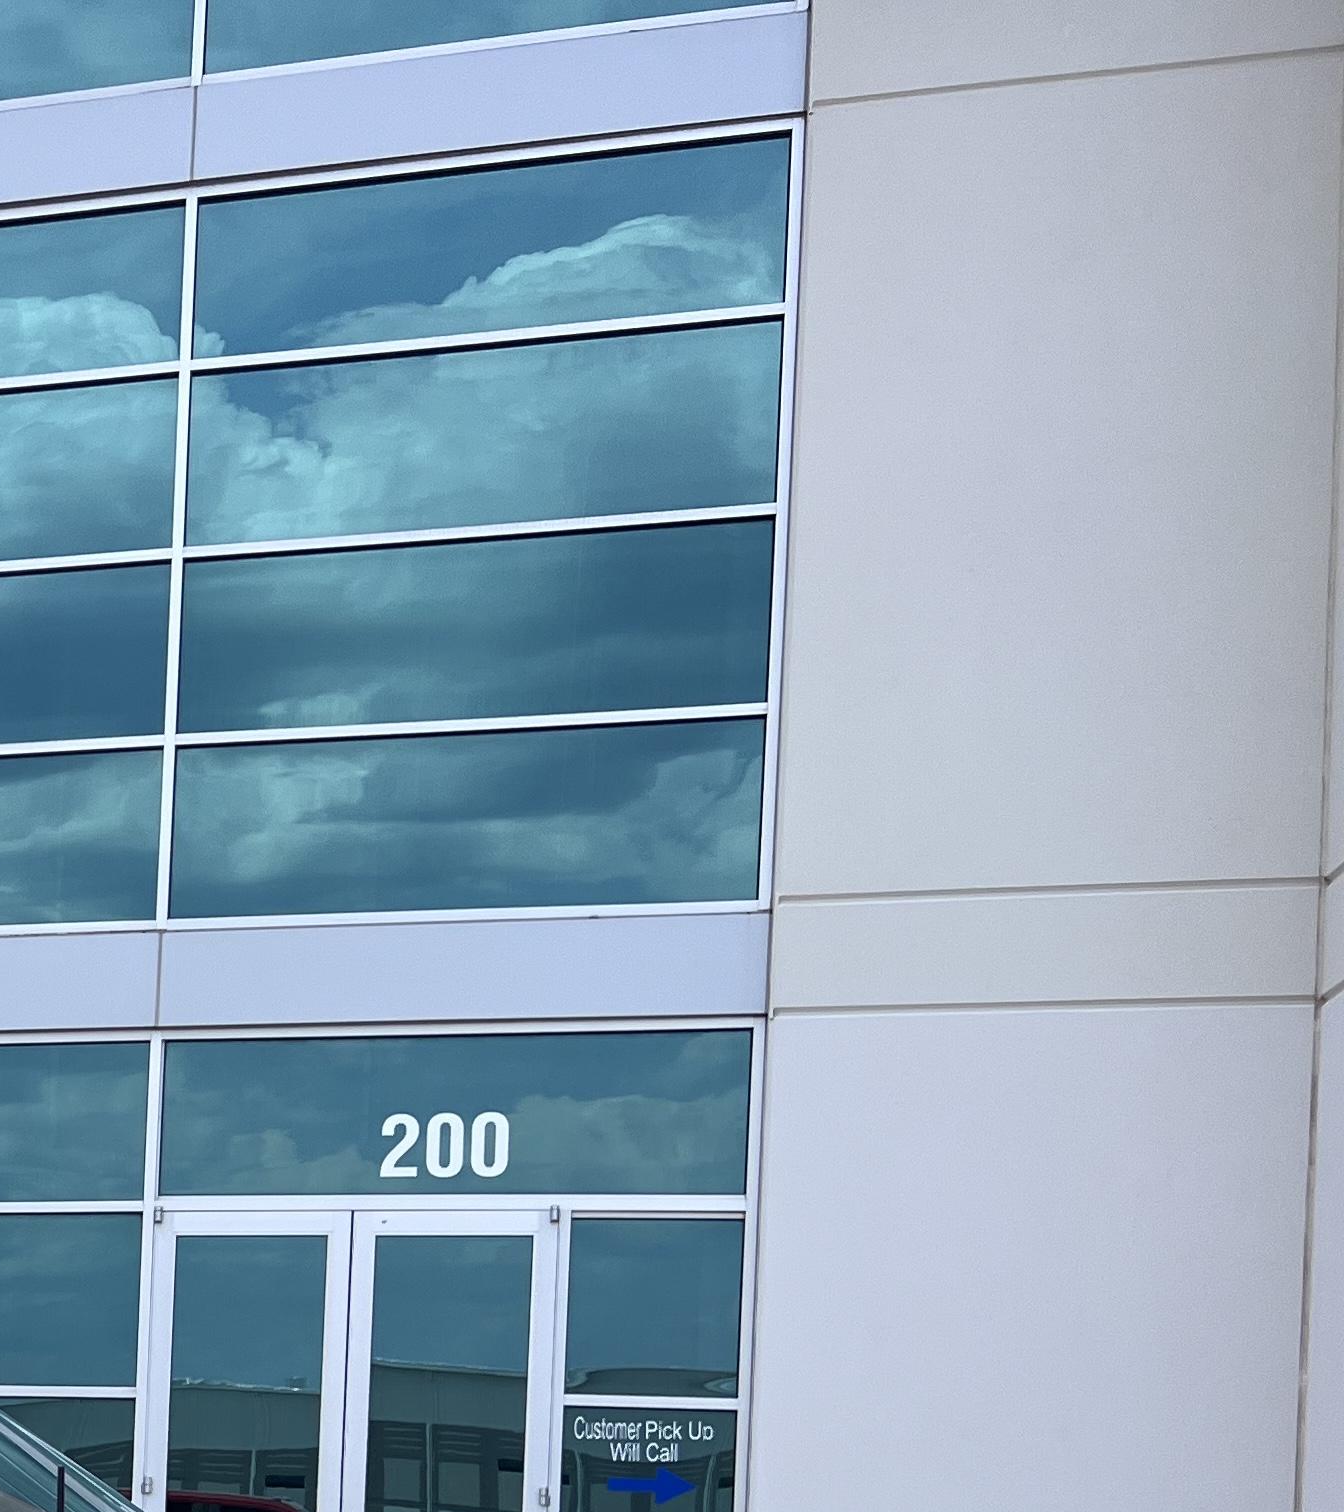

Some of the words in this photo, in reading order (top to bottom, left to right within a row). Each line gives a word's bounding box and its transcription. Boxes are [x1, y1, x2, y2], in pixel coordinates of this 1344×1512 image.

[379, 1111, 510, 1179] 200
[573, 1416, 642, 1440] Customer
[645, 1420, 683, 1440] Pick
[688, 1421, 714, 1441] Up
[610, 1442, 640, 1462] Will
[646, 1442, 679, 1462] Call
